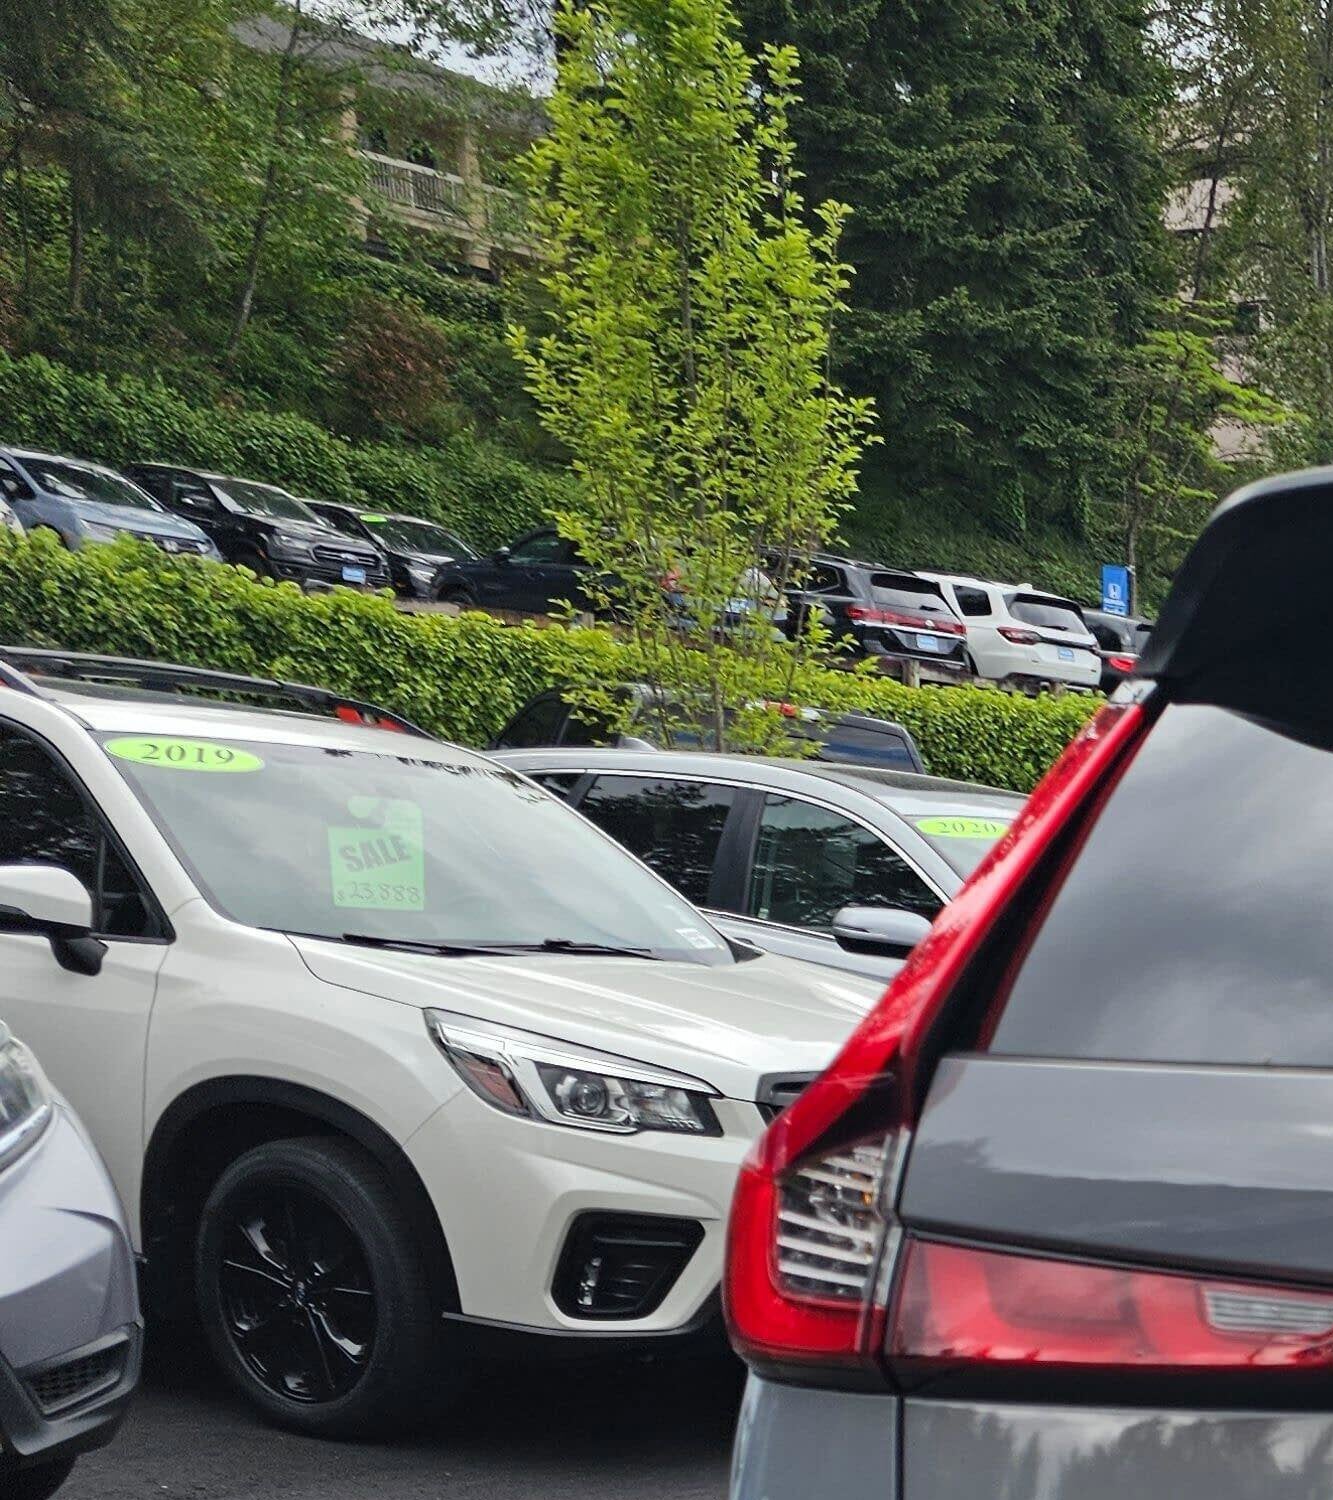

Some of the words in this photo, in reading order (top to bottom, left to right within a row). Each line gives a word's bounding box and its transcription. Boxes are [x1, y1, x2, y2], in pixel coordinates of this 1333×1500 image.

[140, 743, 235, 765] 2019
[937, 821, 998, 833] 2020
[340, 836, 413, 872] SALE
